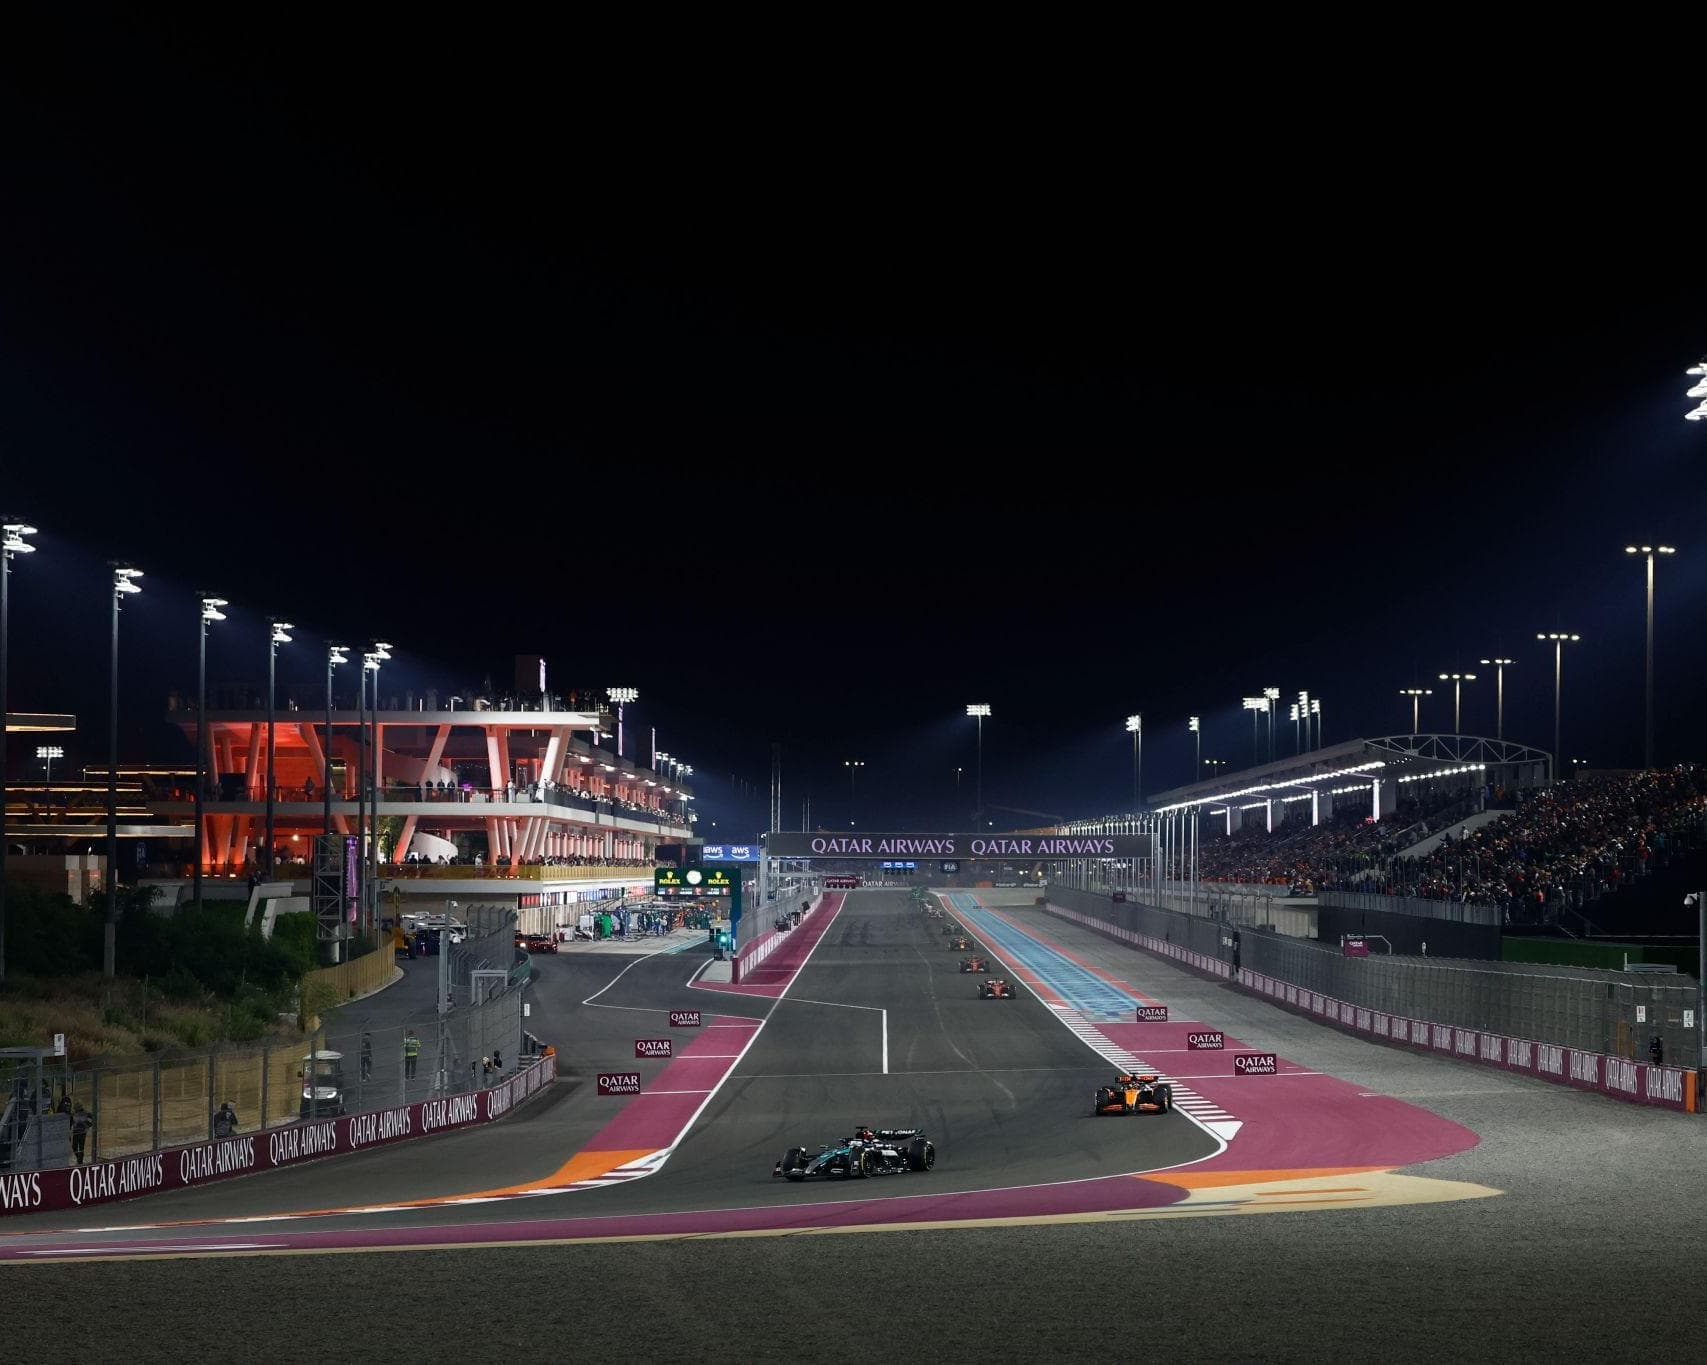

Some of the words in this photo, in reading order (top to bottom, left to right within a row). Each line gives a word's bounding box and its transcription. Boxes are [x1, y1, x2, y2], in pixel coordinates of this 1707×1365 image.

[704, 846, 723, 854] aws
[731, 846, 749, 854] aws
[811, 838, 873, 853] QATAR
[877, 839, 955, 854] AIRWAYS
[971, 839, 1032, 854] QATAR
[1037, 839, 1114, 854] AIRWAYS
[671, 1013, 699, 1022] QATAR
[1137, 1008, 1166, 1016] QATAR
[1189, 1034, 1222, 1043] QATAR
[637, 1041, 670, 1051] QATAR
[1235, 1055, 1275, 1067] QATAR
[1245, 1065, 1275, 1073] AIRWAYS
[599, 1075, 638, 1087] QATAR
[608, 1085, 639, 1093] AIRWAYS
[421, 1101, 447, 1131] QATAR
[448, 1094, 478, 1124] AIRWAYS
[349, 1114, 377, 1148] QATAR
[377, 1107, 411, 1140] AIRWAYS
[269, 1128, 299, 1166] QATAR
[300, 1121, 336, 1156] AIRWAYS
[180, 1145, 214, 1184] QATAR
[215, 1136, 255, 1174] AIRWAYS
[70, 1163, 116, 1205] QATAR
[119, 1154, 163, 1194] AIRWAYS
